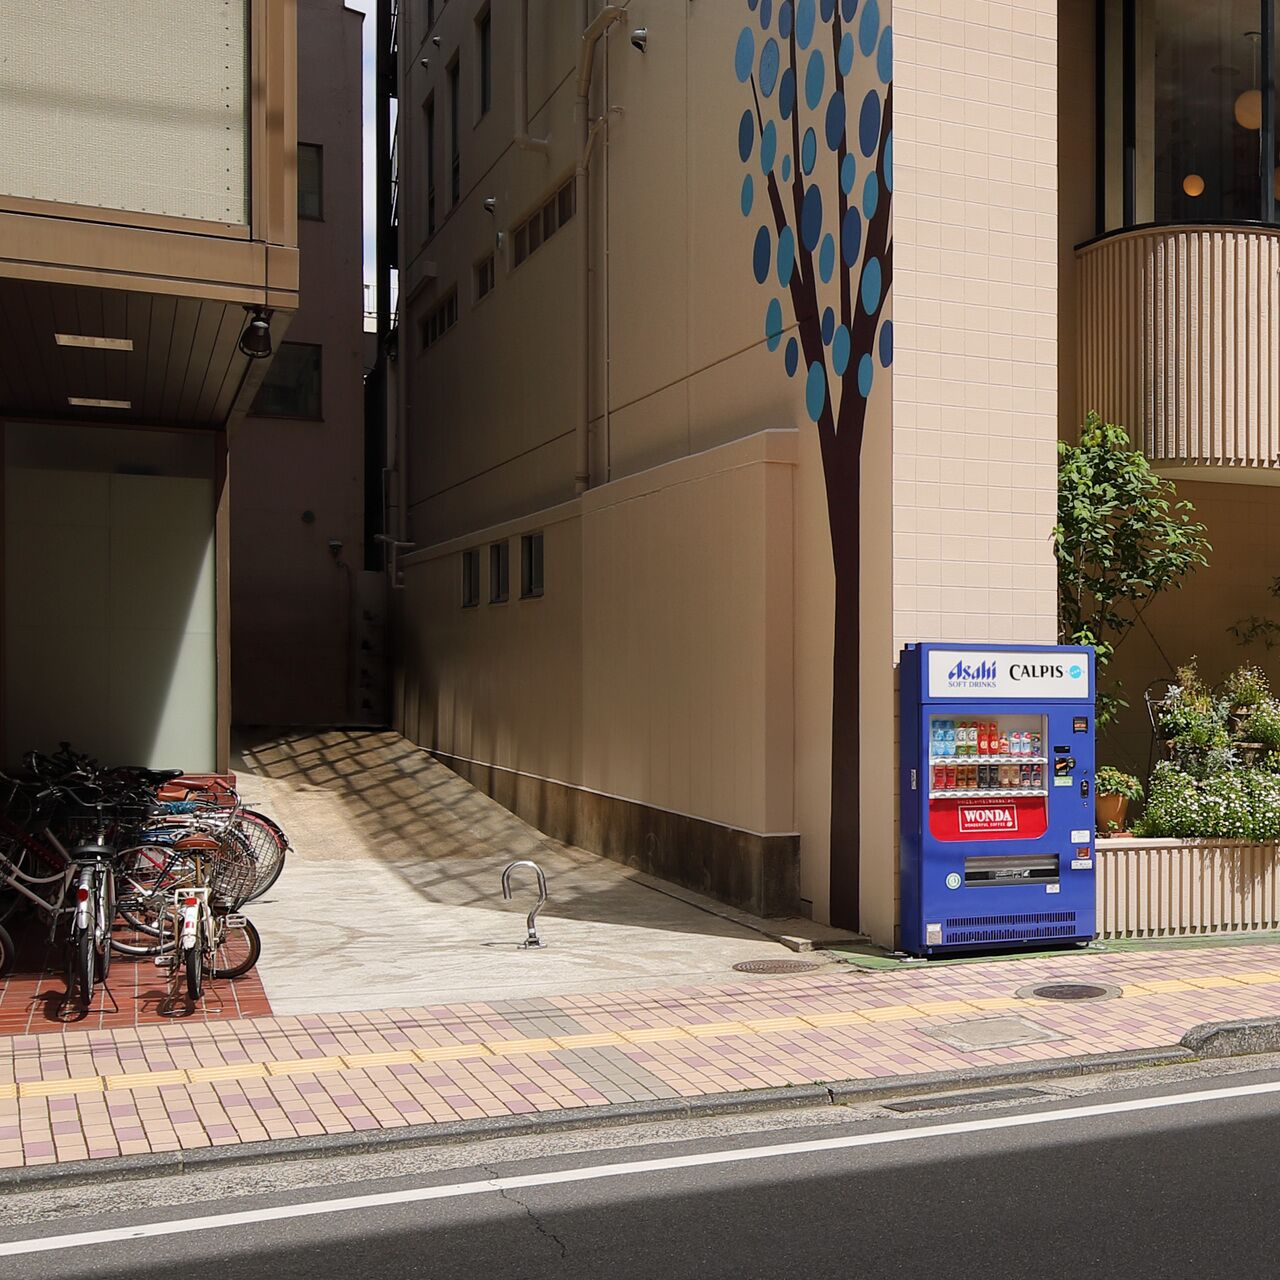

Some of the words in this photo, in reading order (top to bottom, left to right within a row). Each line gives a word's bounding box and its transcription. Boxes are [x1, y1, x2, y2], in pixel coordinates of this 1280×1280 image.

[948, 659, 997, 680] Asahi
[1009, 663, 1064, 681] CALPIS
[963, 809, 1012, 822] WONDA
